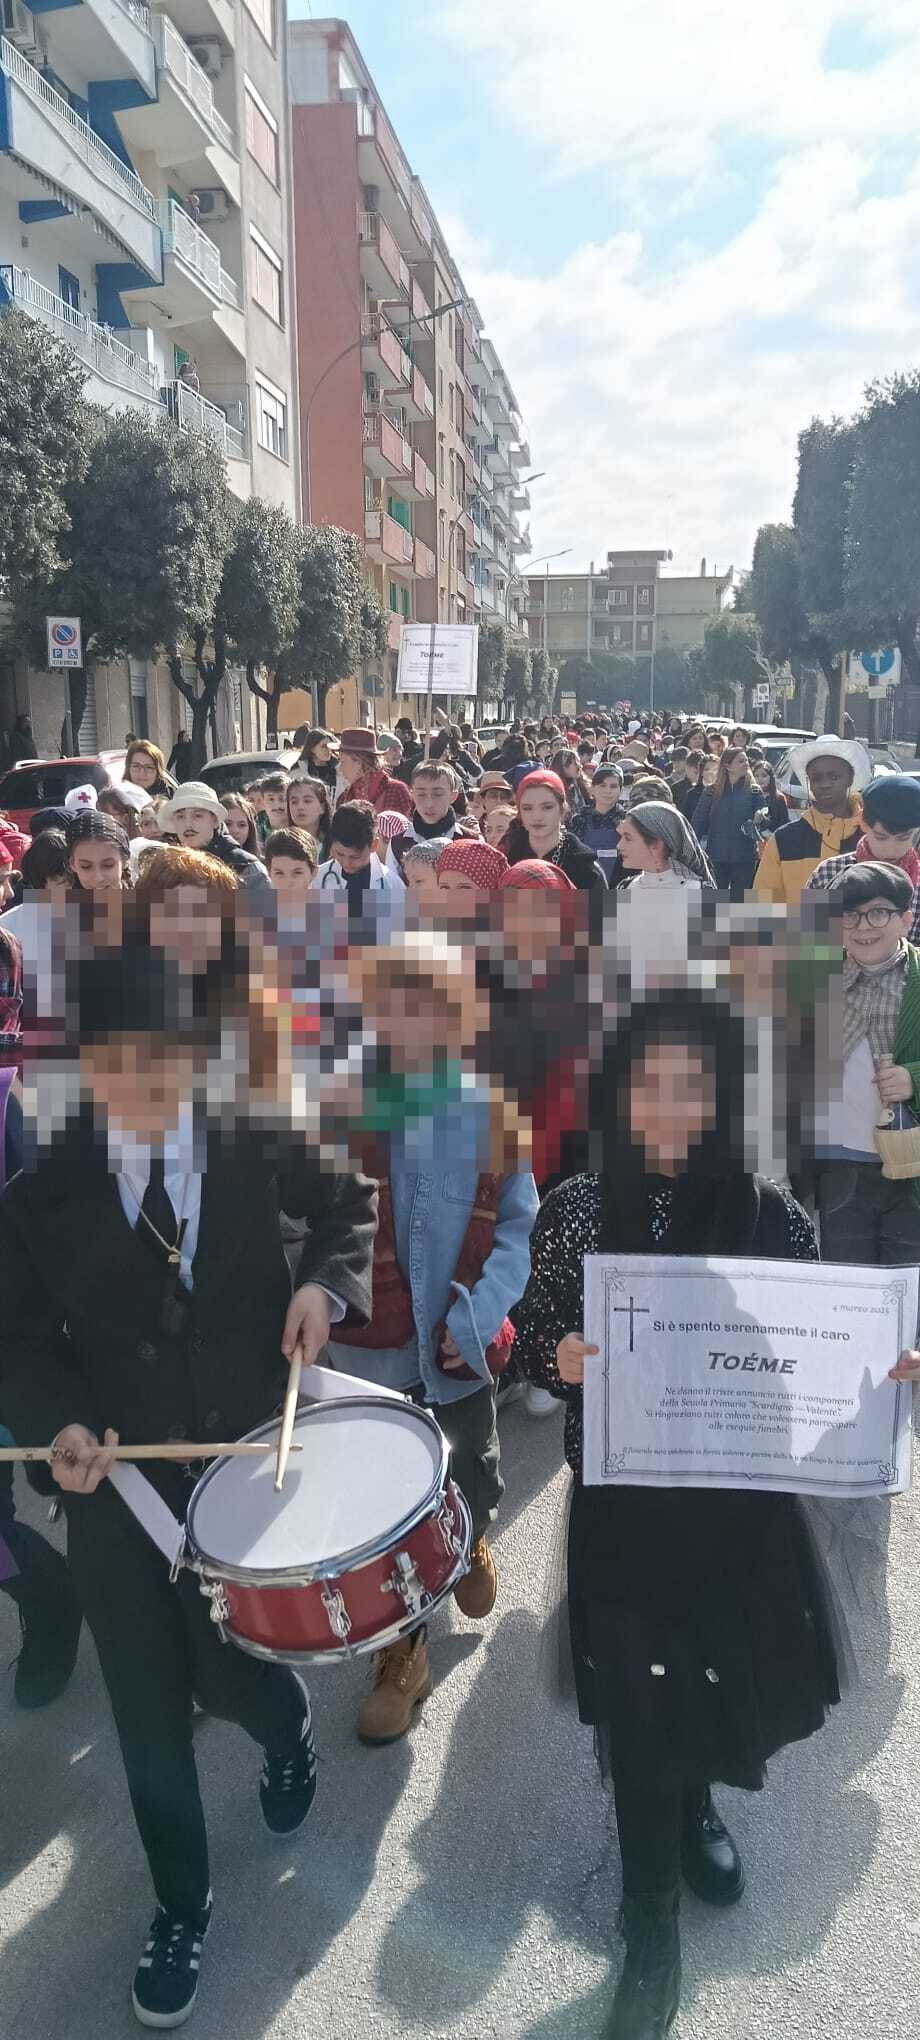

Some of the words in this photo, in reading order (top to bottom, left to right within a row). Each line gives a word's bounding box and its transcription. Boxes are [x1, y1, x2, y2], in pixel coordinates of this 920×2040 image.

[840, 1305, 868, 1313] marzo
[653, 1320, 665, 1332] Si
[668, 1320, 676, 1331] è
[679, 1321, 721, 1334] spento
[724, 1323, 807, 1337] serenamente
[811, 1327, 818, 1338] il
[821, 1330, 851, 1341] caro
[659, 1399, 679, 1407] della
[681, 1399, 708, 1407] Scuola
[710, 1399, 746, 1409] Primaria
[665, 1387, 676, 1396] Ne
[678, 1386, 704, 1396] danno
[705, 1387, 711, 1397] il
[736, 1388, 775, 1399] annuncio
[778, 1390, 797, 1401] tutti
[803, 1395, 855, 1407] componenti
[655, 1409, 702, 1421] ringraziano
[704, 1410, 723, 1419] tutti
[724, 1410, 751, 1420] coloro
[753, 1413, 767, 1421] che
[808, 1417, 858, 1430] partecipare
[708, 1421, 724, 1431] alle
